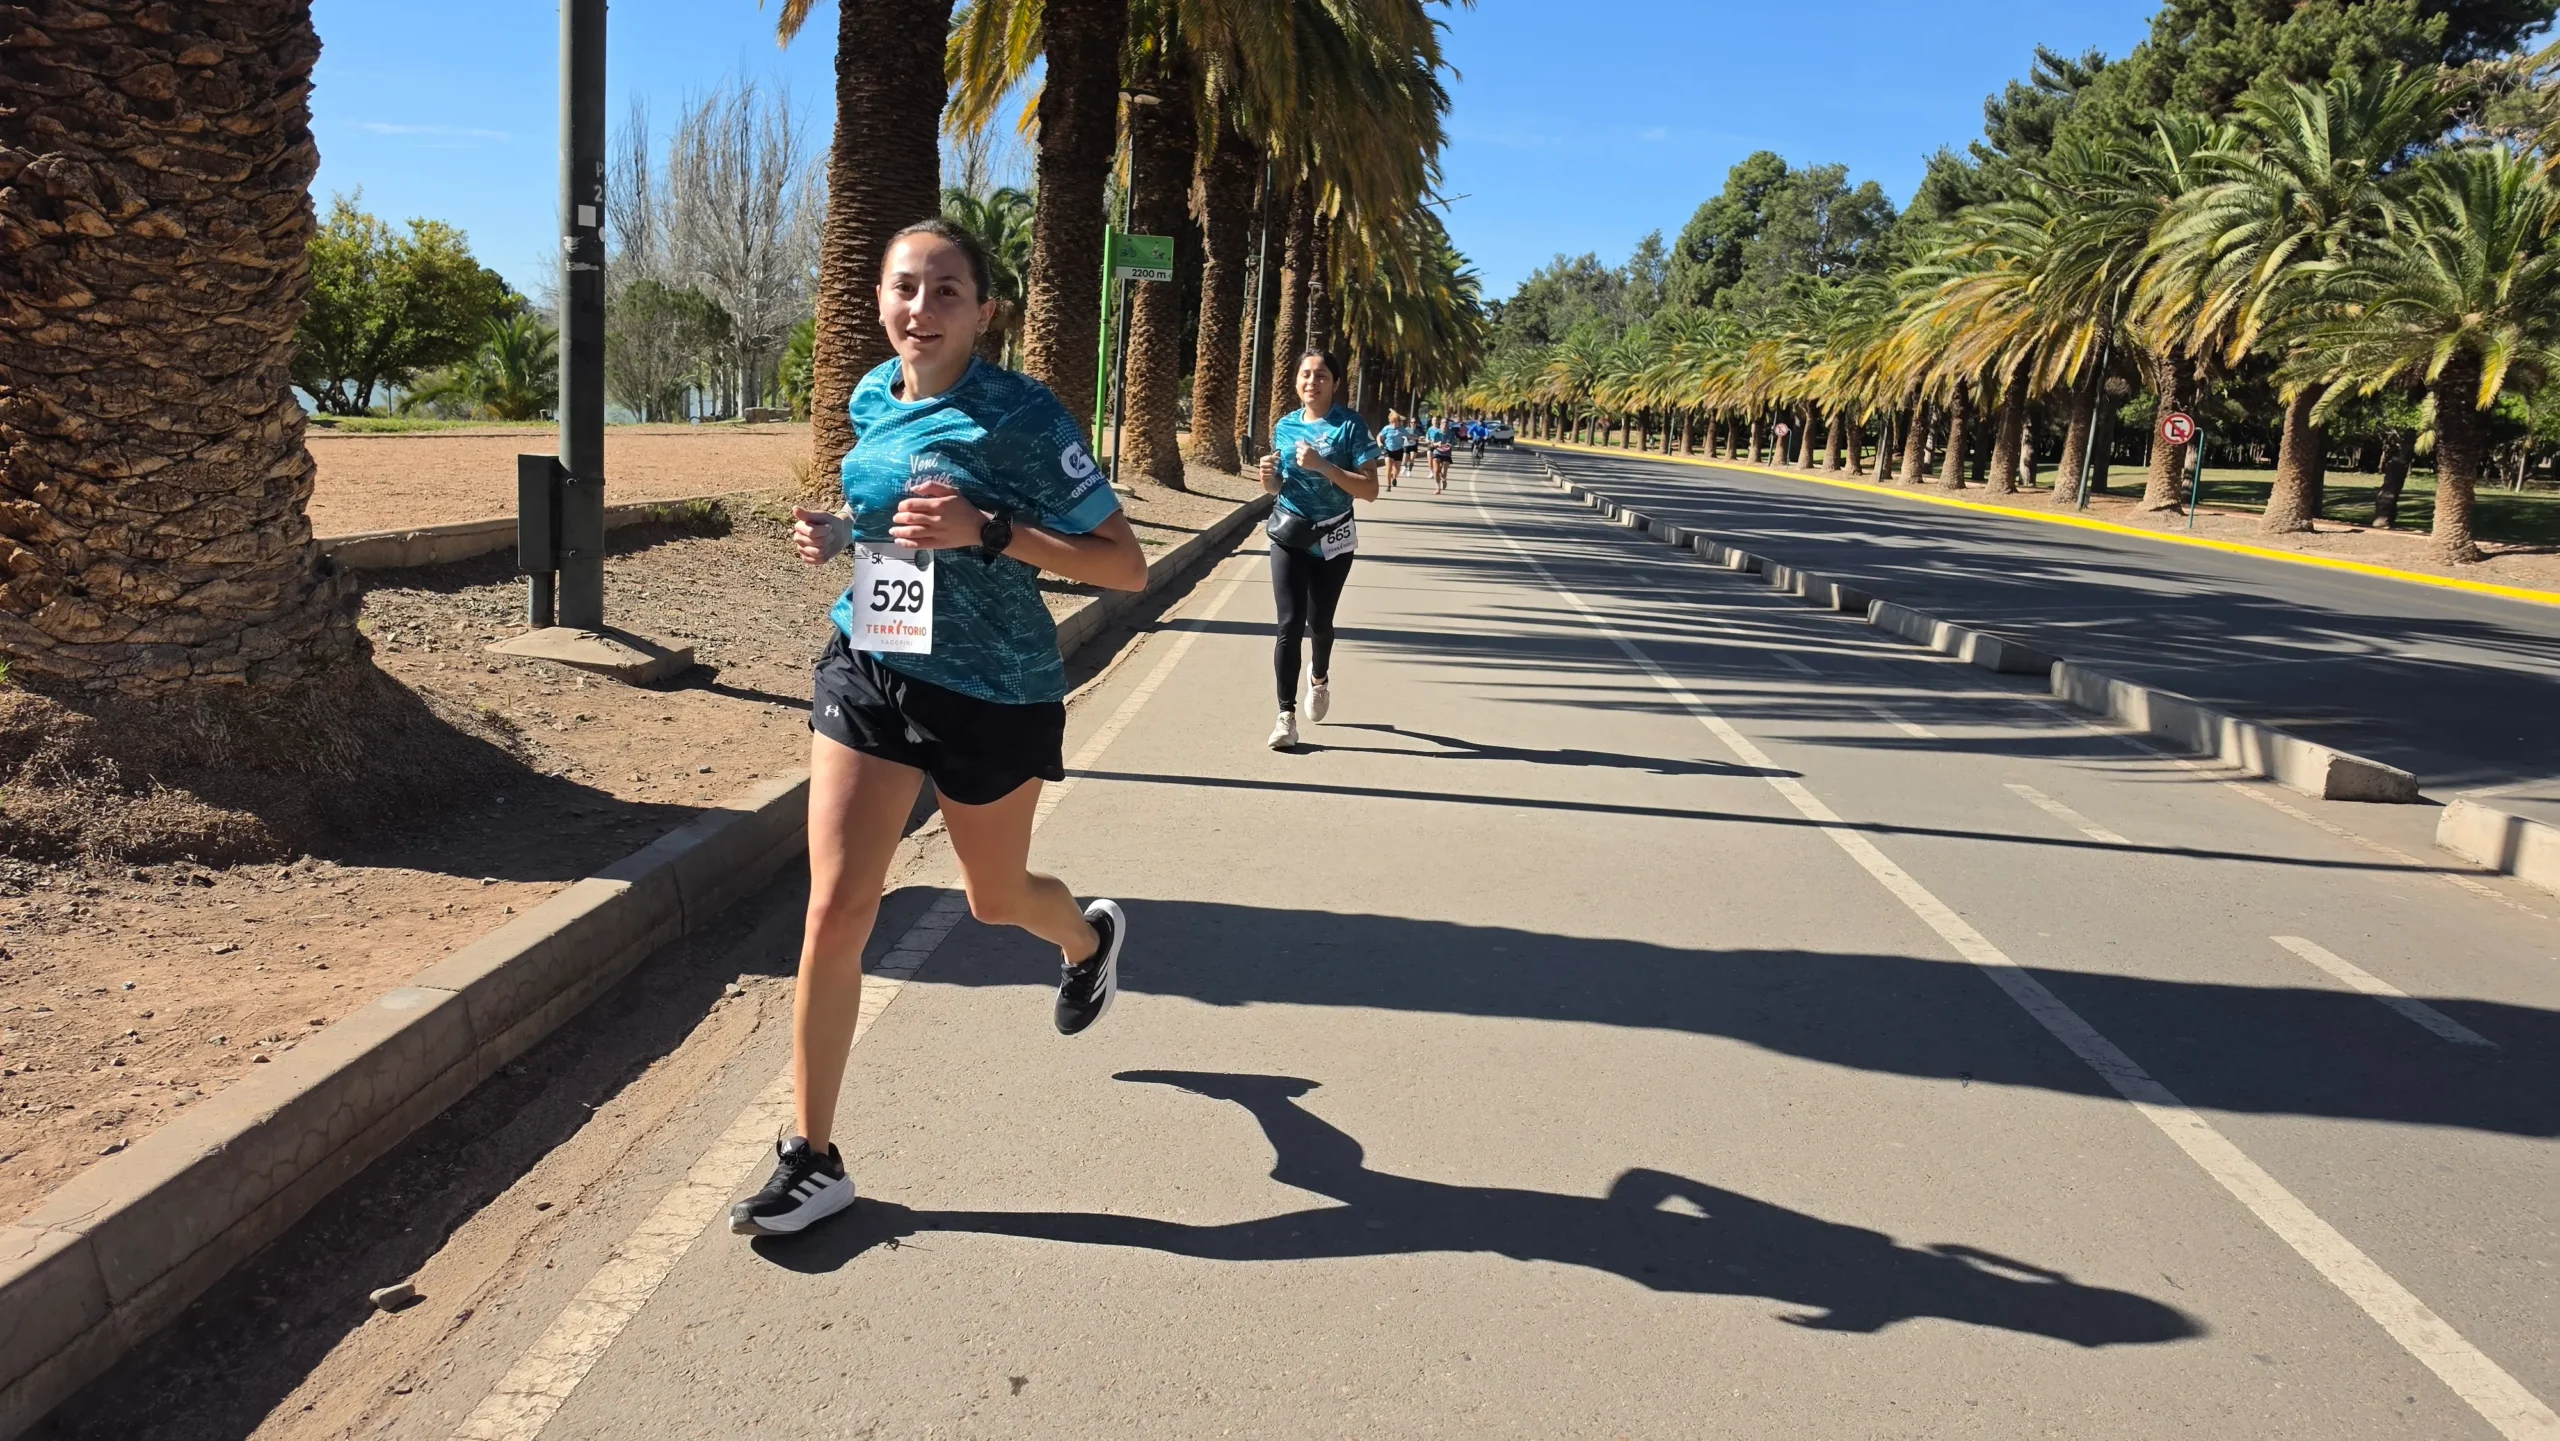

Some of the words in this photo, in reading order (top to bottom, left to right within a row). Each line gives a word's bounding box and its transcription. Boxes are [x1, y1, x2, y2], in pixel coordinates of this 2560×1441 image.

[594, 184, 603, 203] 2
[1132, 268, 1155, 278] 2200
[1156, 271, 1167, 279] m
[1327, 525, 1351, 545] 665
[869, 579, 924, 614] 529
[866, 619, 927, 637] TERRITORIO
